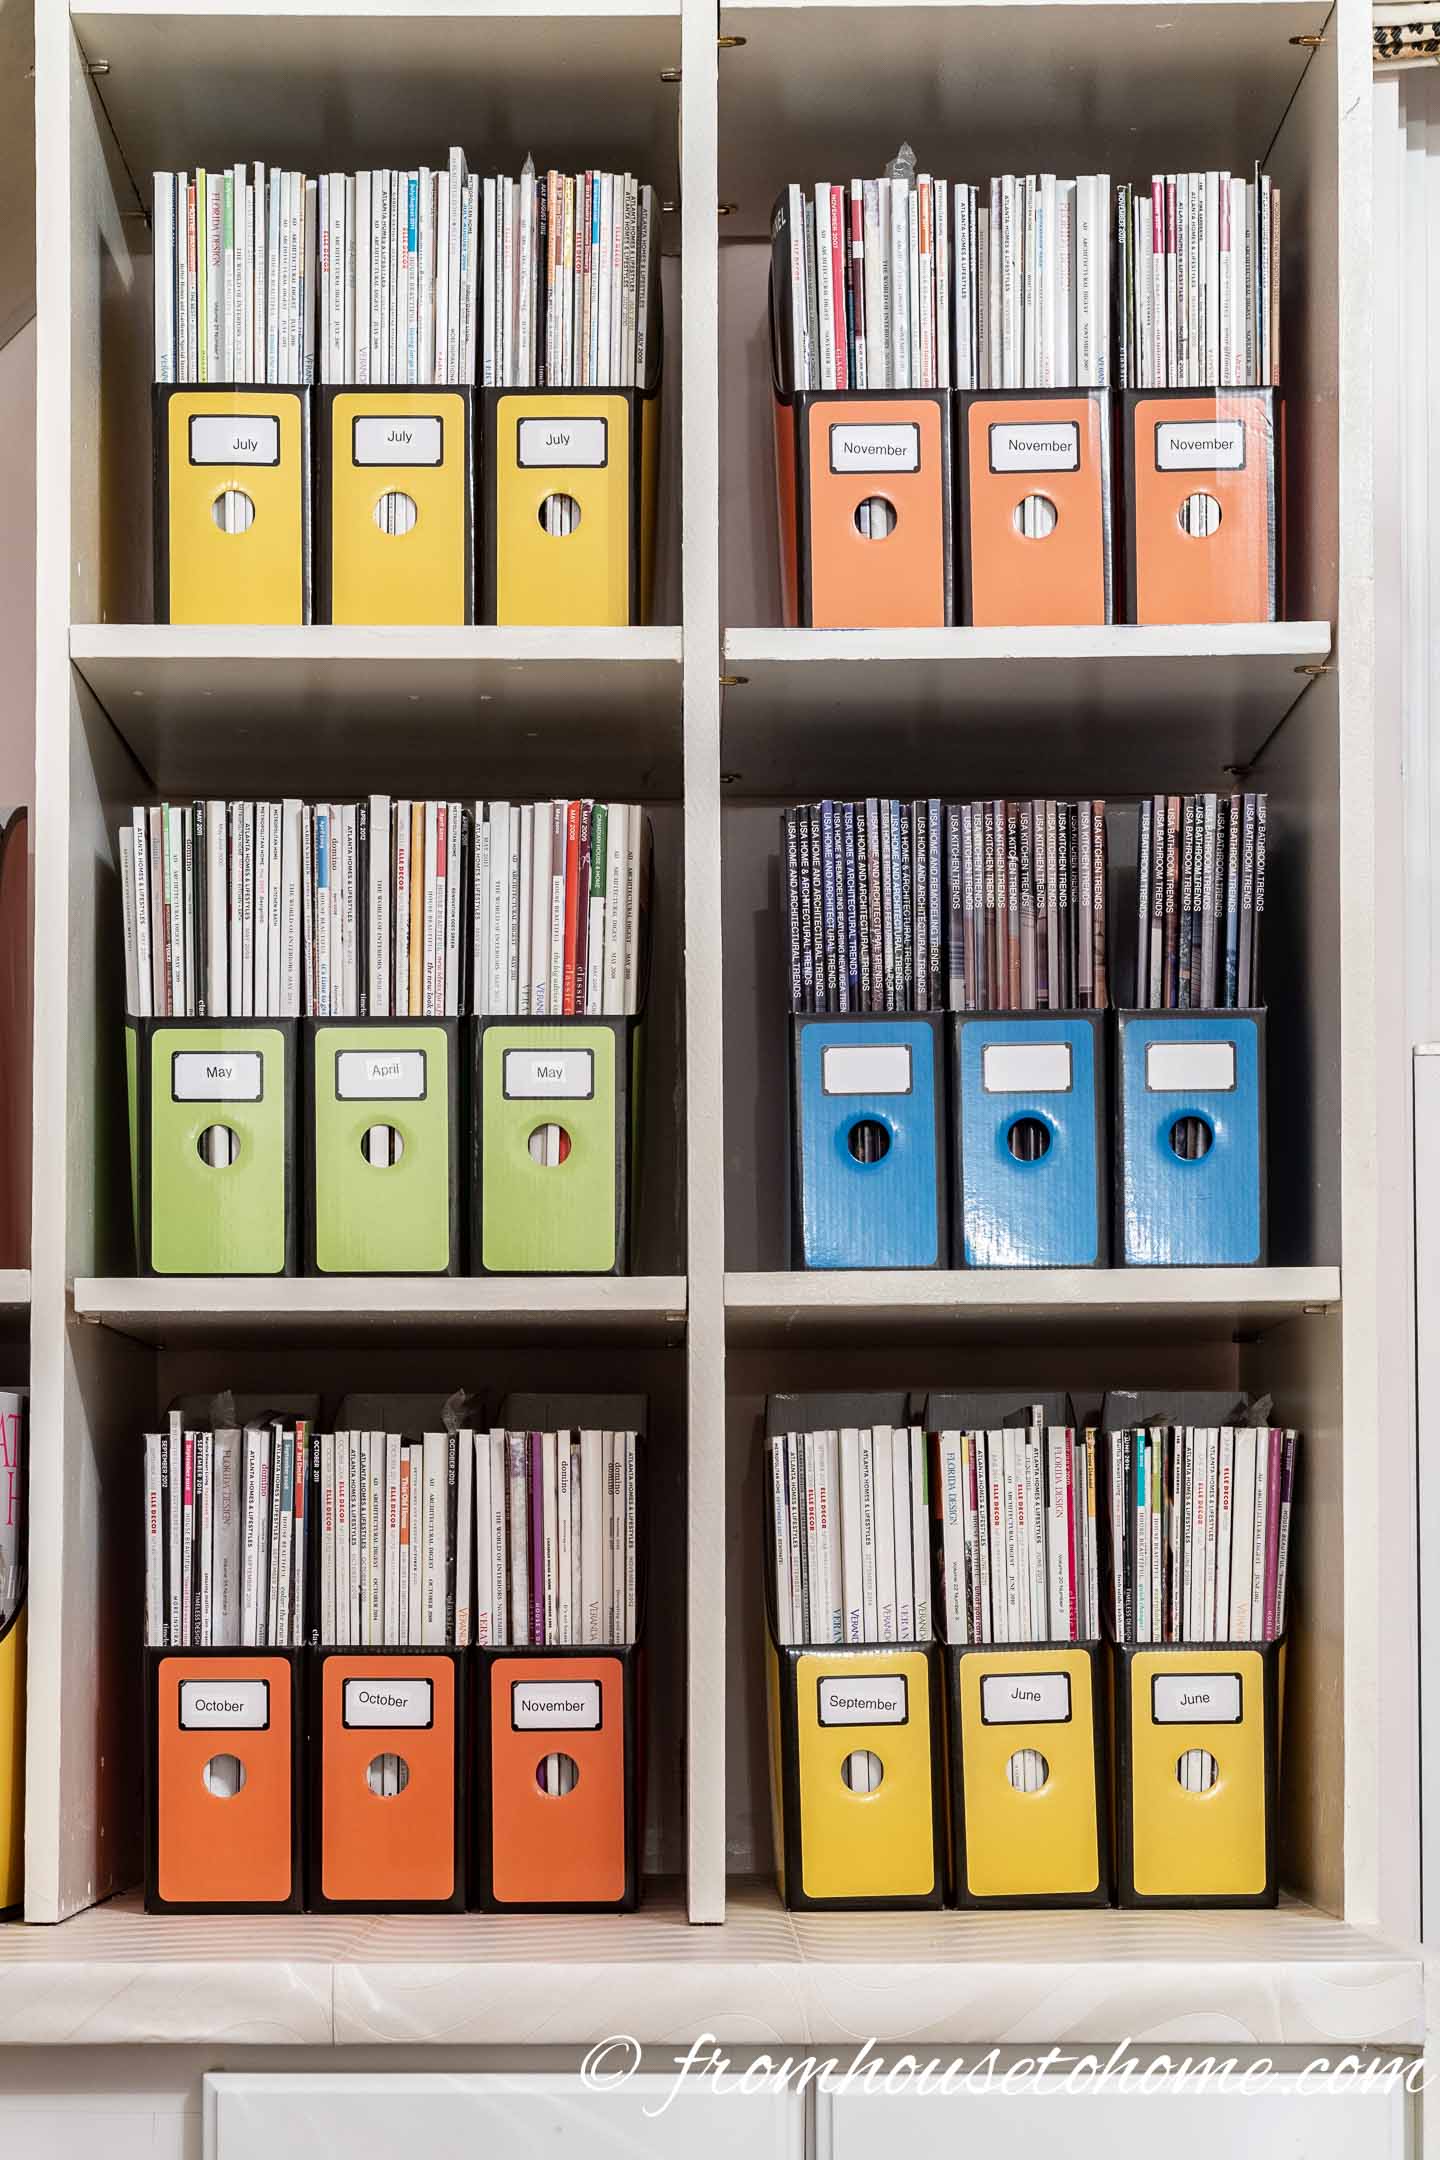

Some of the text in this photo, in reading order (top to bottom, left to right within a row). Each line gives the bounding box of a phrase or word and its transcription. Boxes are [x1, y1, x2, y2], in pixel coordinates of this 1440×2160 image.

[232, 438, 258, 451] July
[387, 430, 412, 444] July
[546, 434, 570, 446] July
[844, 442, 908, 456] November
[1008, 439, 1072, 453] November
[1170, 438, 1234, 451] November
[788, 822, 796, 839] USA
[800, 821, 808, 839] USA
[811, 820, 820, 839] USA
[845, 812, 854, 829] USA
[857, 815, 865, 833] USA
[901, 817, 909, 836] USA
[788, 842, 797, 866] HOME
[800, 841, 809, 867] HOME
[812, 840, 820, 865] HOME
[846, 833, 854, 858] HOME
[902, 837, 910, 862] HOME
[1021, 833, 1029, 870] KITCHEN
[1059, 833, 1067, 871] KITCHEN
[1094, 835, 1102, 873] KITCHEN
[1154, 830, 1163, 880] BATHROOM
[1243, 804, 1254, 909] USA BATHROOM TRENDS
[1257, 826, 1266, 875] BATHROOM
[951, 814, 960, 910] USA KITCHEN TRENDS
[985, 814, 994, 908] USA KITCHEN TRENDS
[1166, 808, 1175, 913] USA BATHROOM TRENDS
[1228, 808, 1238, 913] USA BATHROOM TRENDS
[813, 868, 821, 886] AND
[1059, 872, 1067, 908] TRENDS
[1094, 874, 1102, 910] TRENDS
[1154, 882, 1163, 917] TRENDS
[1256, 877, 1265, 912] TRENDS
[802, 876, 811, 948] ARCHITECTURAL
[847, 868, 856, 939] ARCHITECTURAL
[902, 872, 911, 944] ARCHITECTURAL
[790, 889, 799, 961] ARCHITECTURAL
[813, 889, 822, 960] ARCHITECTURAL
[859, 882, 868, 955] ARCHITECTURAL
[917, 885, 926, 955] ARCHITECTURAL
[803, 950, 812, 985] TRENDS
[849, 942, 857, 975] TRENDS
[792, 963, 800, 998] TRENDS
[206, 1066, 232, 1079] May
[372, 1064, 400, 1078] April
[536, 1066, 563, 1080] May
[947, 1453, 958, 1526] FLORIDA DESIGN
[194, 1698, 244, 1712] October
[358, 1691, 408, 1708] October
[522, 1700, 585, 1713] November
[830, 1695, 897, 1712] September
[1010, 1687, 1041, 1702] June
[1180, 1693, 1210, 1706] June
